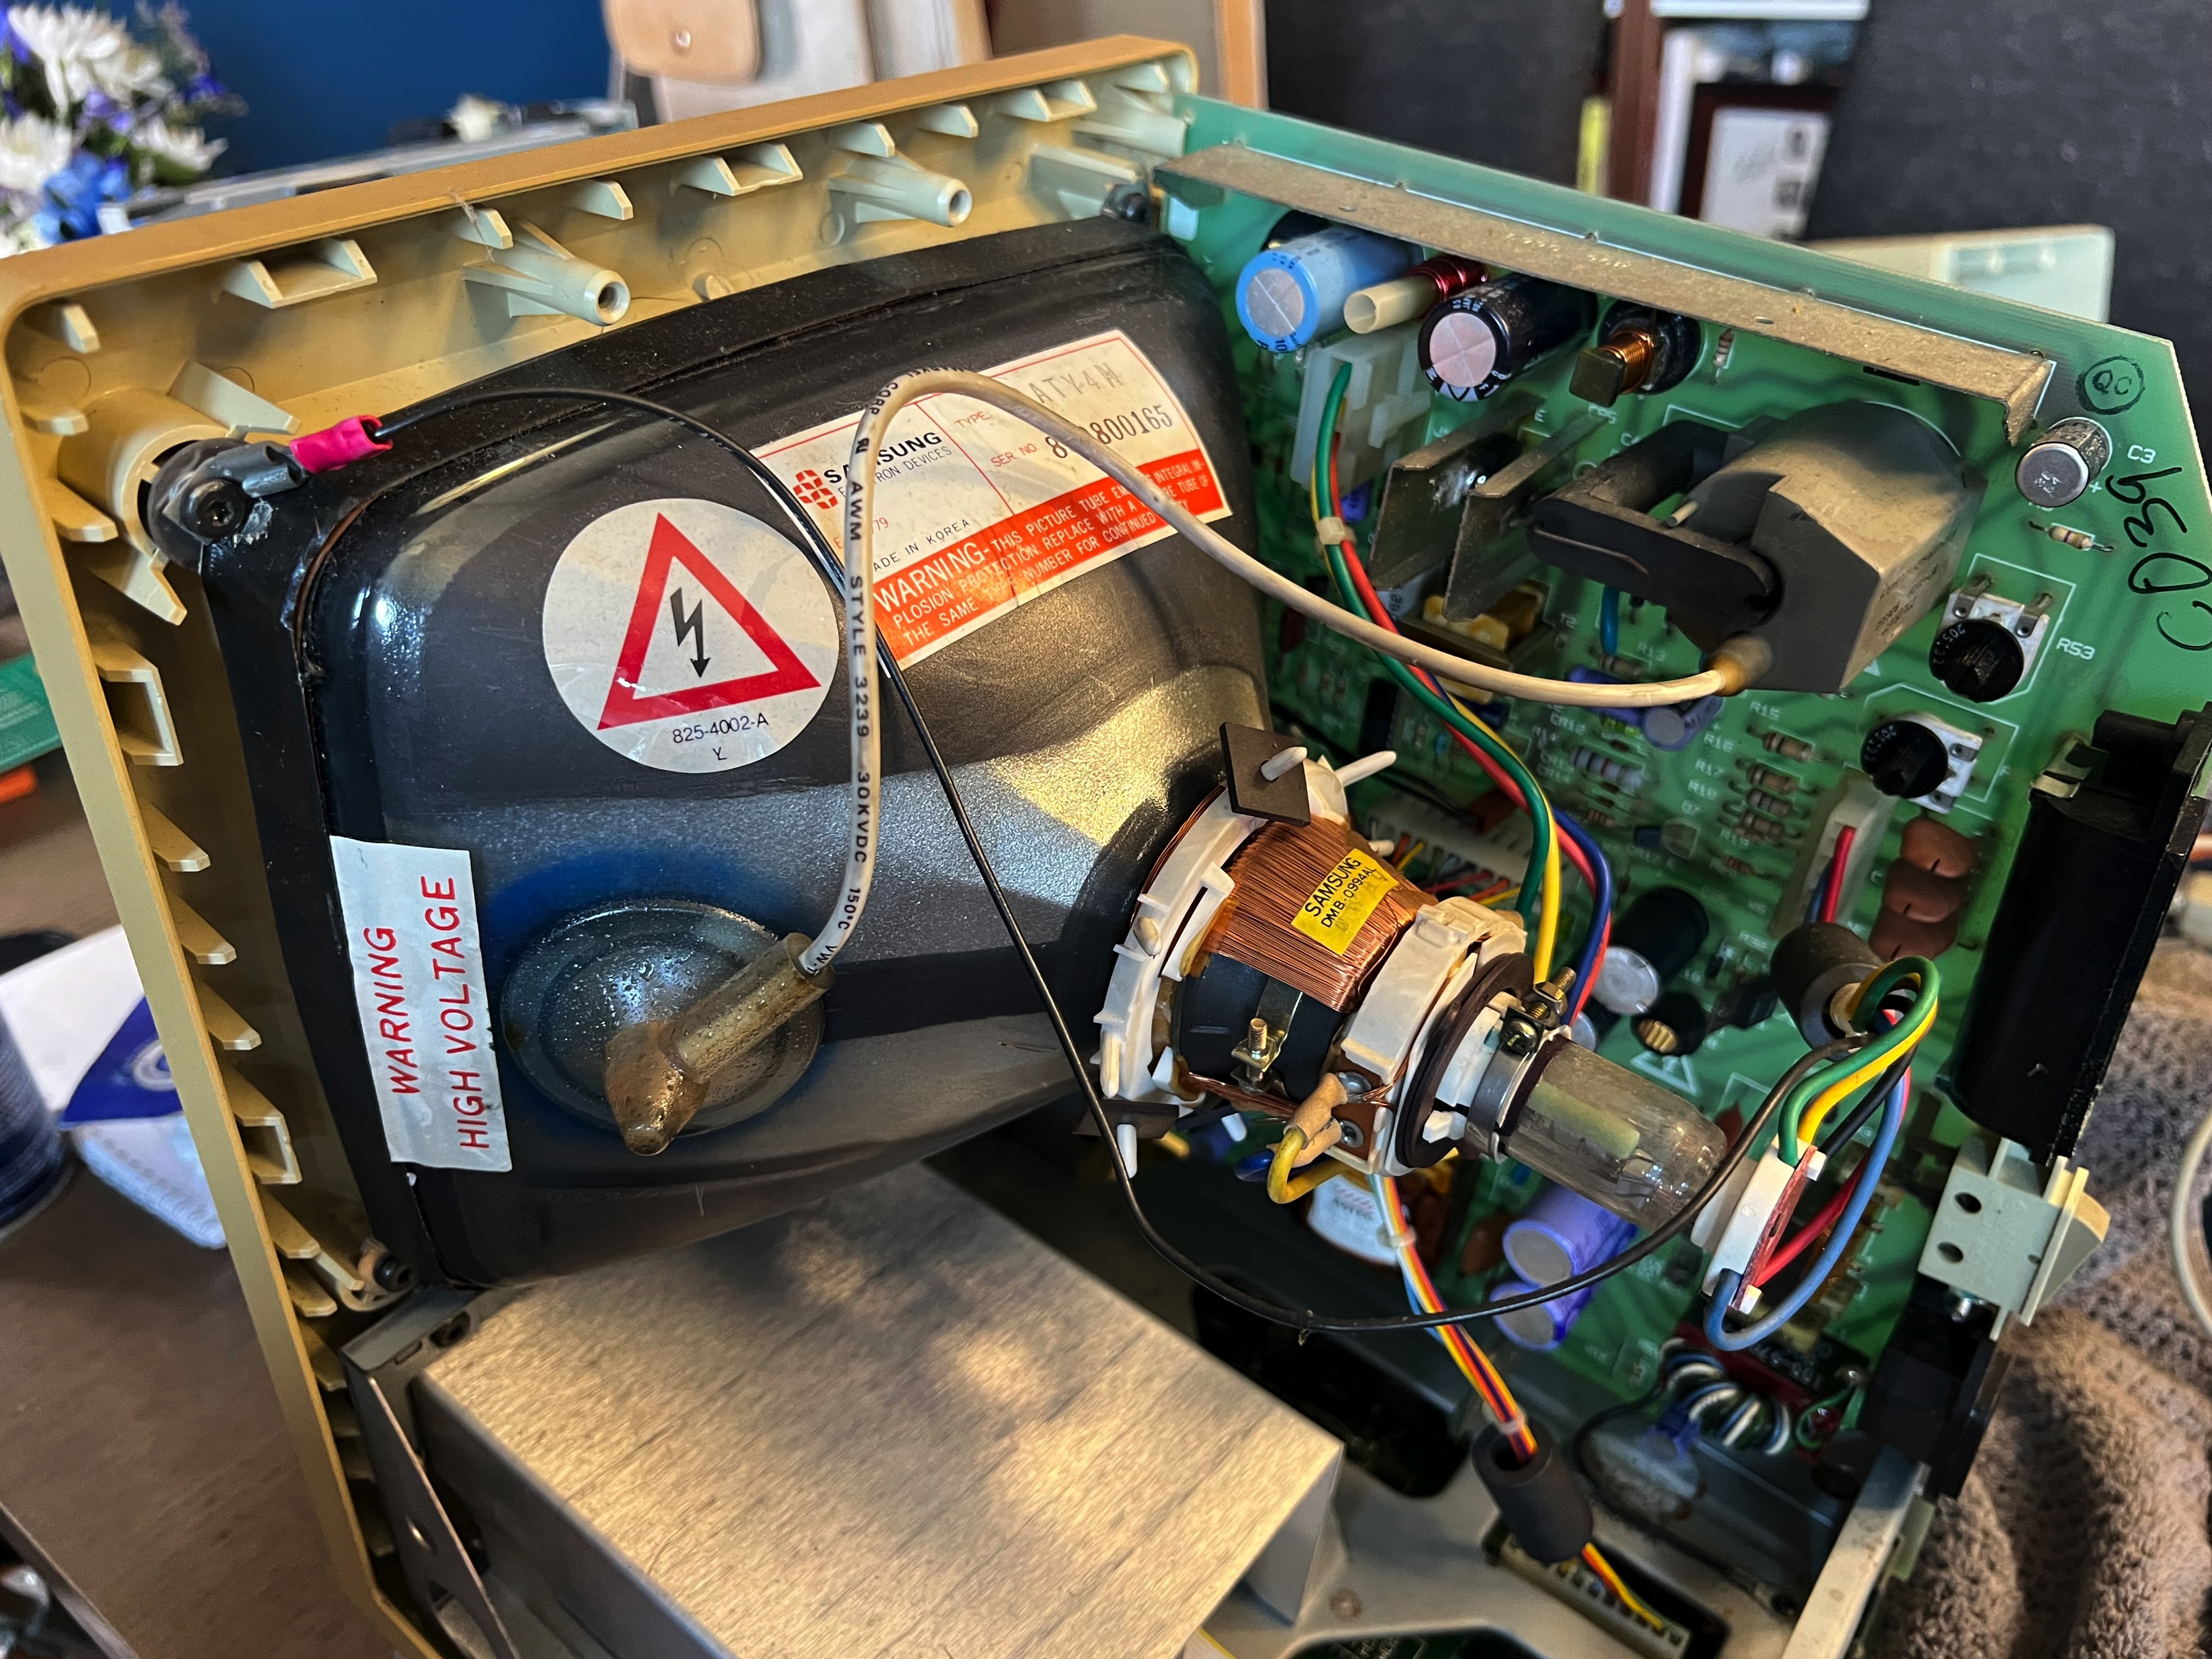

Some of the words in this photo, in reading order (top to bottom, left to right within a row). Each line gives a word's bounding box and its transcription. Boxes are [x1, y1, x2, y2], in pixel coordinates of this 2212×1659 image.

[903, 446, 952, 471] DEVICES
[2127, 444, 2157, 464] C3
[850, 481, 864, 541] AWM
[991, 531, 1023, 553] THIS
[1025, 505, 1077, 537] PICTURE
[1079, 492, 1110, 512] TUBE
[873, 552, 901, 571] ADE
[905, 543, 919, 556] IN
[926, 518, 970, 545] KOREA
[892, 587, 955, 629] PLOSION
[1042, 518, 1095, 551] REPLACE
[1096, 504, 1125, 525] WITH
[1128, 500, 1138, 512] A
[1178, 479, 1200, 494] TUBE
[903, 621, 935, 646] THE
[939, 597, 979, 627] SAME
[1022, 549, 1074, 582] NUMBER
[1075, 535, 1101, 556] FOR
[1102, 512, 1156, 543] CONTINUED
[850, 575, 866, 656] STYLE
[672, 712, 769, 743] 825-4002-A
[855, 676, 870, 738] 3239
[855, 771, 871, 864] 30KVDC
[1304, 857, 1362, 917] SAMSUNG
[420, 875, 477, 1054] VOLTAGE
[363, 927, 420, 1094] WARNING
[449, 1070, 490, 1149] HIGH
